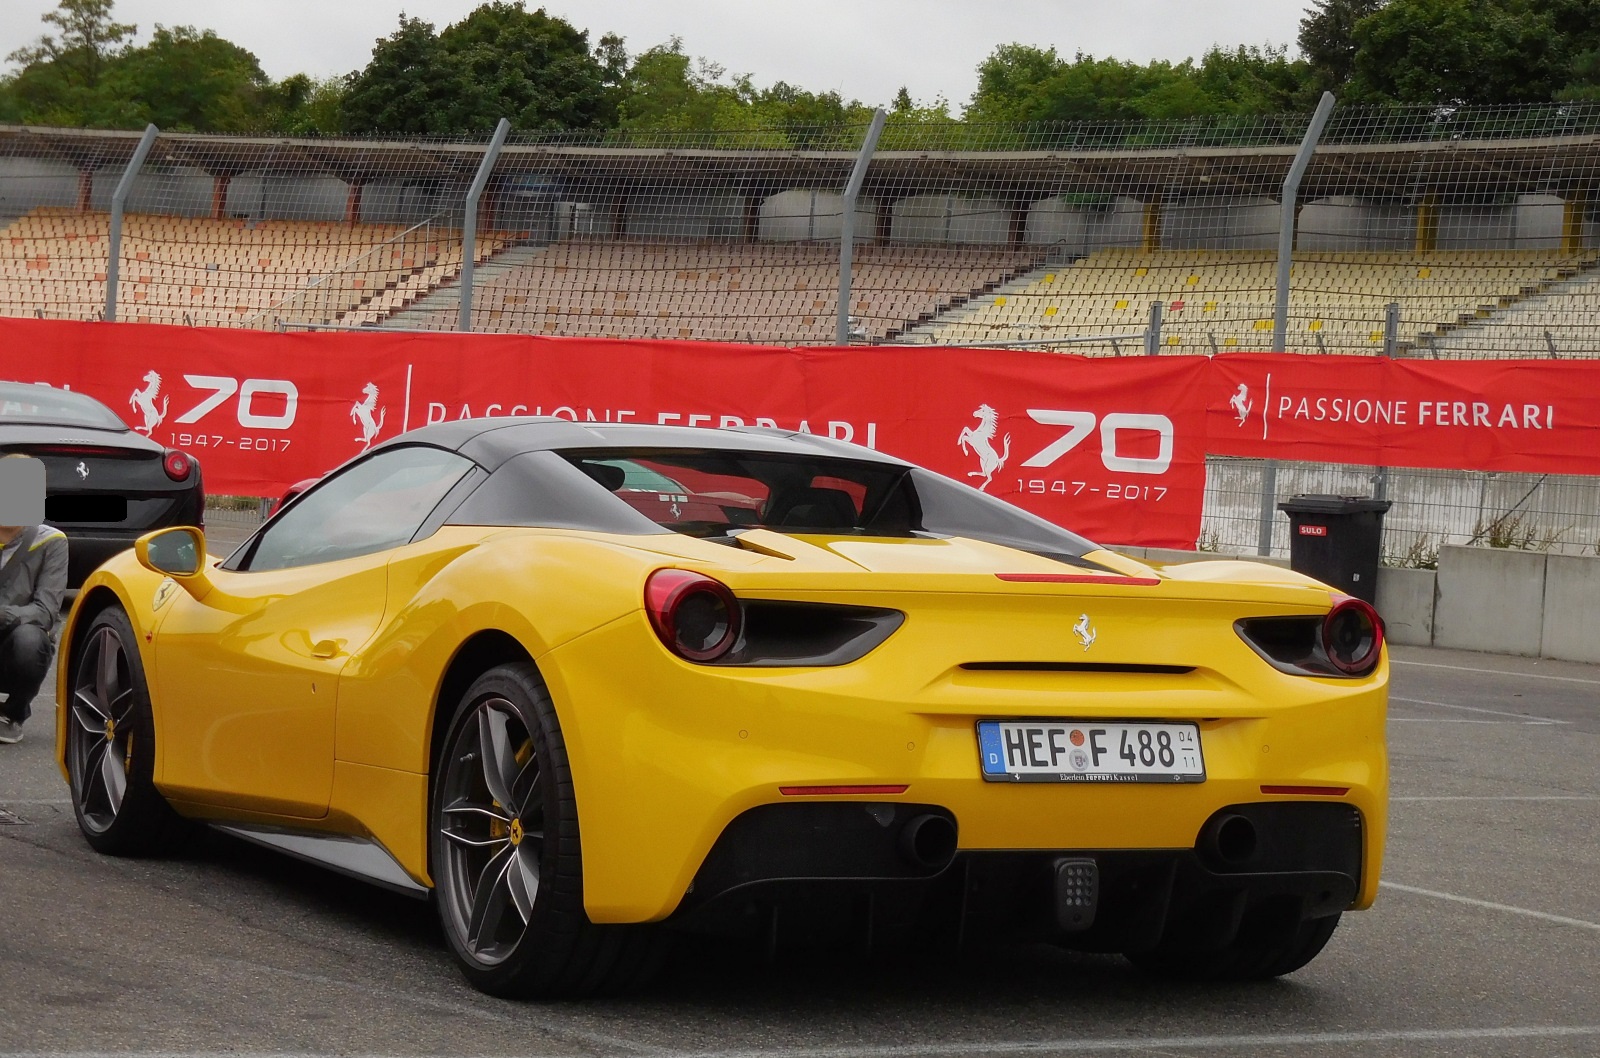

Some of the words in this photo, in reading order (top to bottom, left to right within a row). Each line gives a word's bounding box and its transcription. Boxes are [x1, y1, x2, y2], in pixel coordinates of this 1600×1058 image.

[174, 375, 298, 429] 70
[1279, 396, 1407, 425] PASSIONE
[1418, 402, 1554, 429] FERRARI
[171, 433, 291, 452] 1947-2017
[1020, 409, 1173, 475] 70
[1017, 479, 1168, 501] 1947-2017
[1301, 526, 1322, 535] SULO
[1179, 731, 1193, 742] 04
[1004, 729, 1066, 767] HEF
[1089, 729, 1107, 767] F
[1119, 729, 1175, 767] 488
[989, 753, 998, 764] D
[1183, 756, 1196, 768] 11
[1060, 773, 1085, 781] Eberlein
[1085, 773, 1113, 781] Ferrari
[1113, 773, 1138, 781] Kassel
